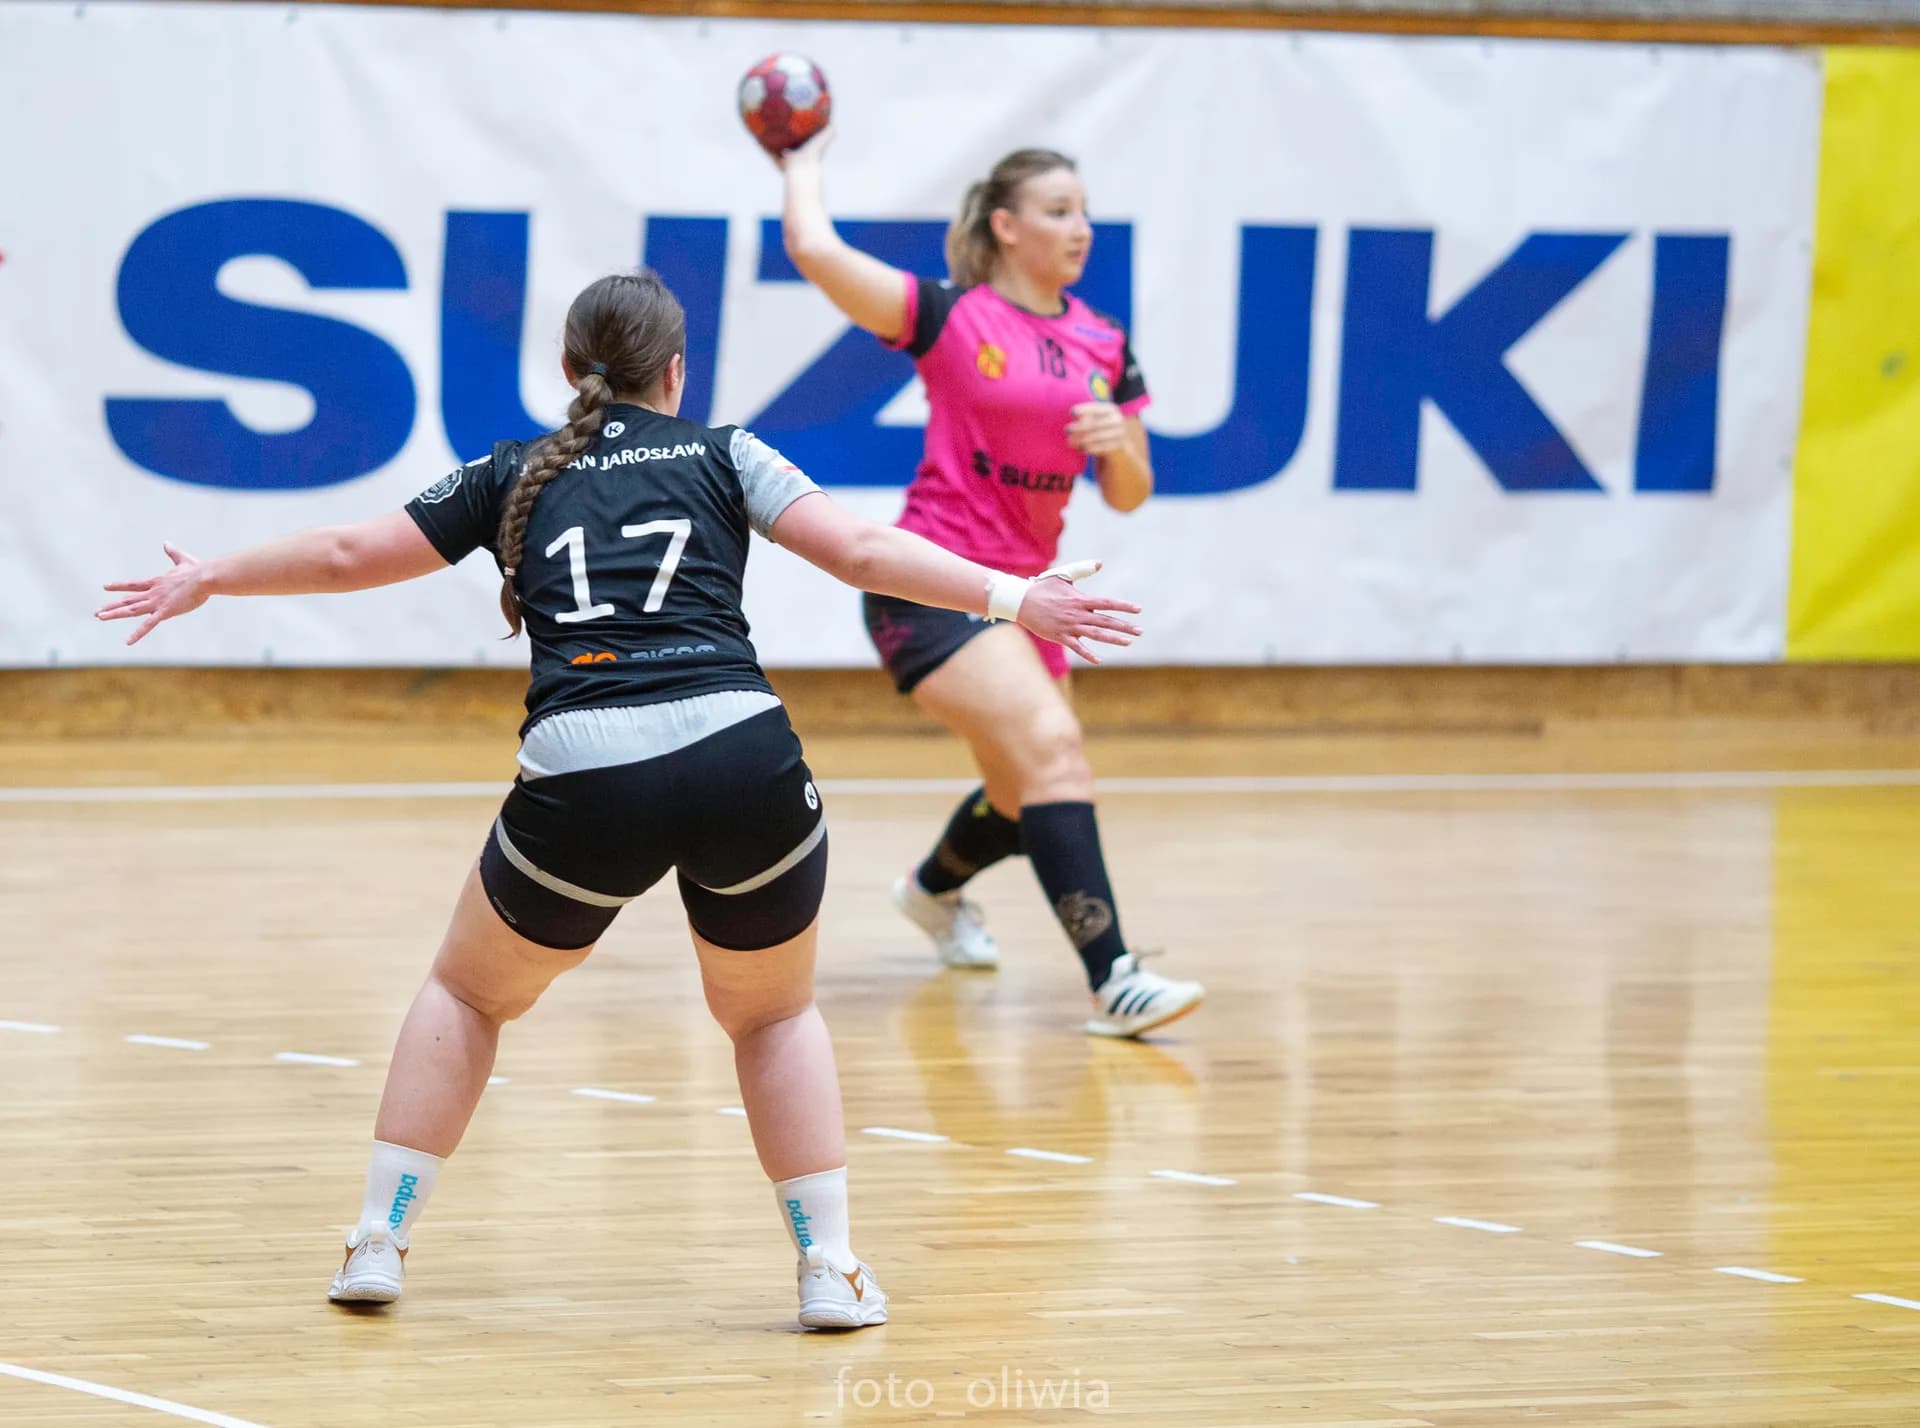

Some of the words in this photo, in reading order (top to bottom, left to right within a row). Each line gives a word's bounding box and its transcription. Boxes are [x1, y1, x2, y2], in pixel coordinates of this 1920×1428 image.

[104, 197, 1731, 496] SUZUKI
[599, 441, 706, 471] JAROSŁAW
[545, 518, 692, 624] 17
[786, 1199, 812, 1256] empa
